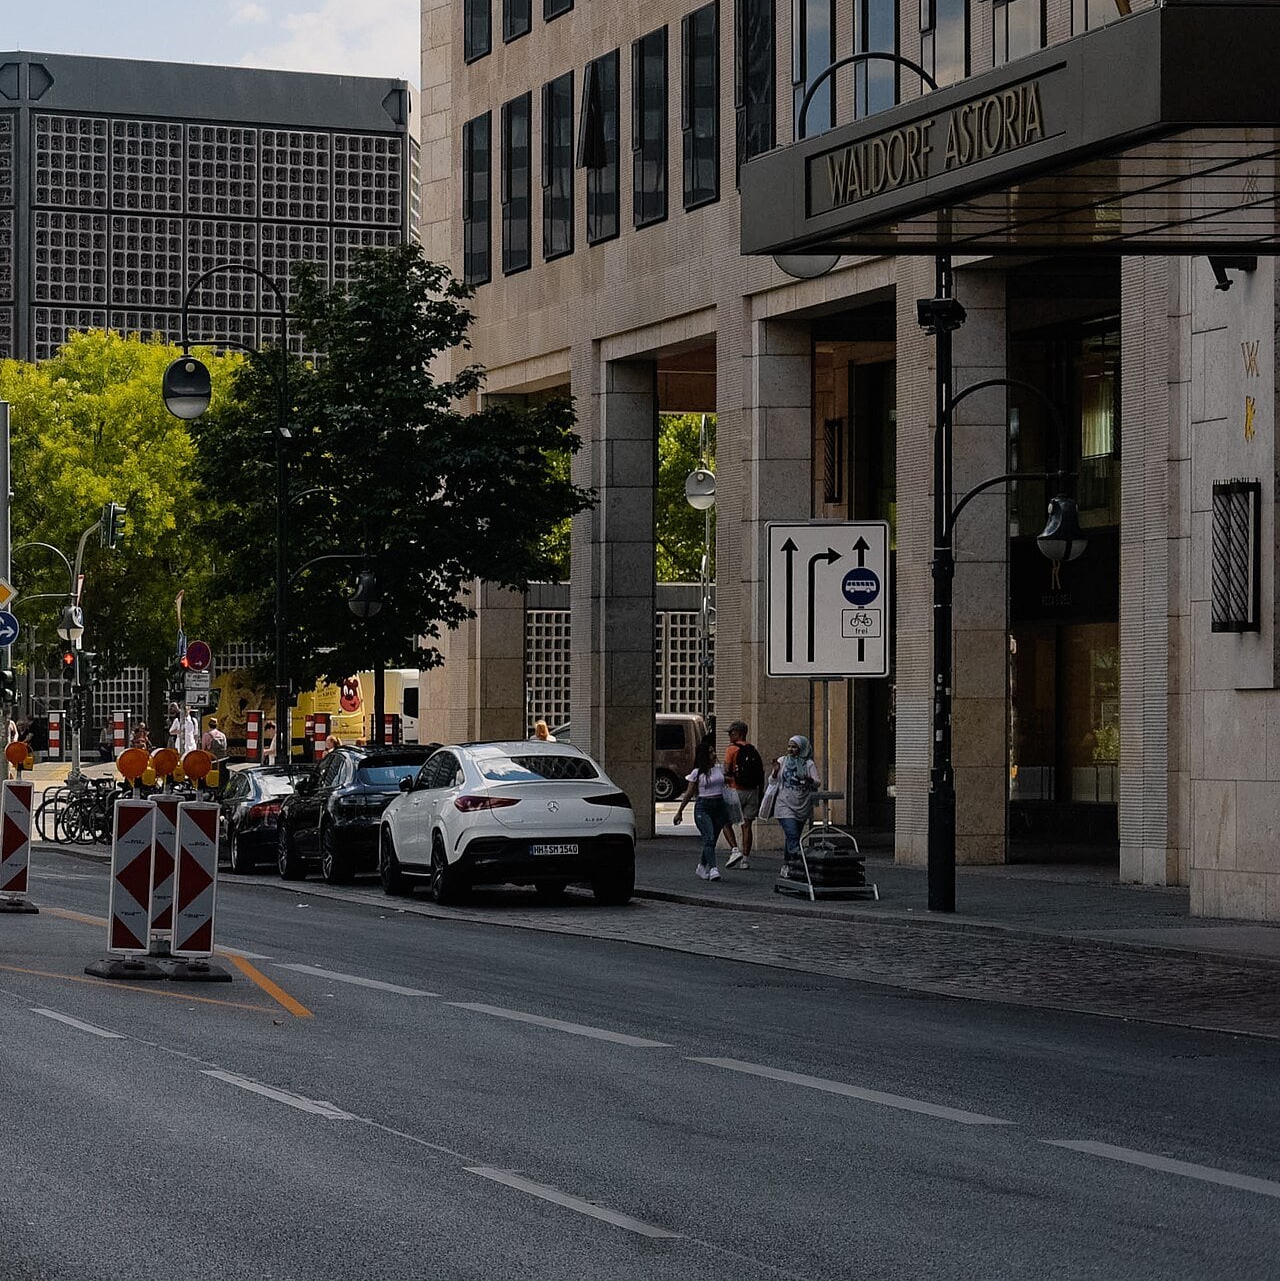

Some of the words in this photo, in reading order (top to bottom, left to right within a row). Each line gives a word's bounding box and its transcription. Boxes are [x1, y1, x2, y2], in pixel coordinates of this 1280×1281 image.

[827, 119, 936, 207] WALDORF
[944, 82, 1046, 169] ASTORIA
[855, 627, 868, 635] frei
